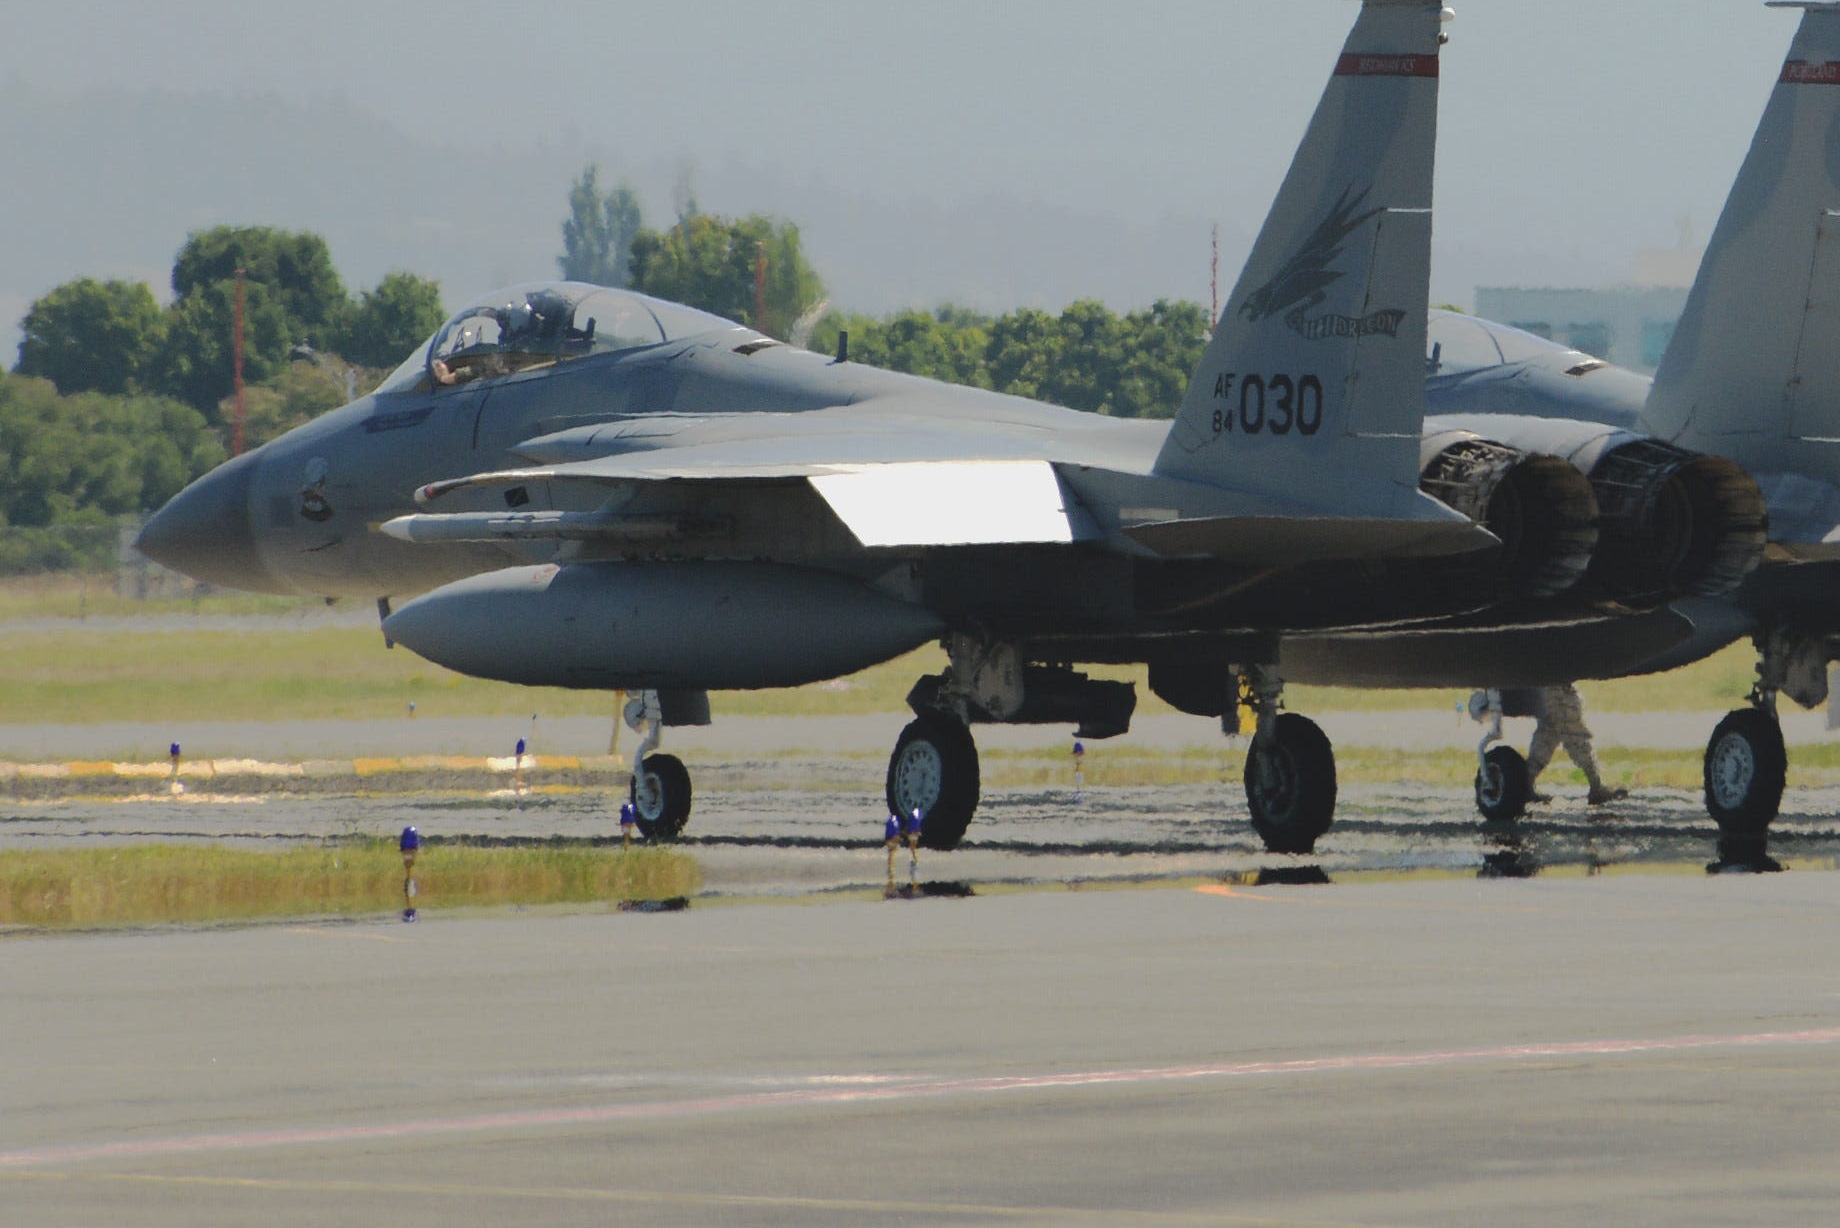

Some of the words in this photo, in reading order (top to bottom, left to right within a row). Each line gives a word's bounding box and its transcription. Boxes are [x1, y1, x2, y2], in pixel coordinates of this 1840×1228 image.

[1213, 372, 1236, 399] AF
[1240, 373, 1323, 436] 030
[1212, 408, 1234, 433] 84
